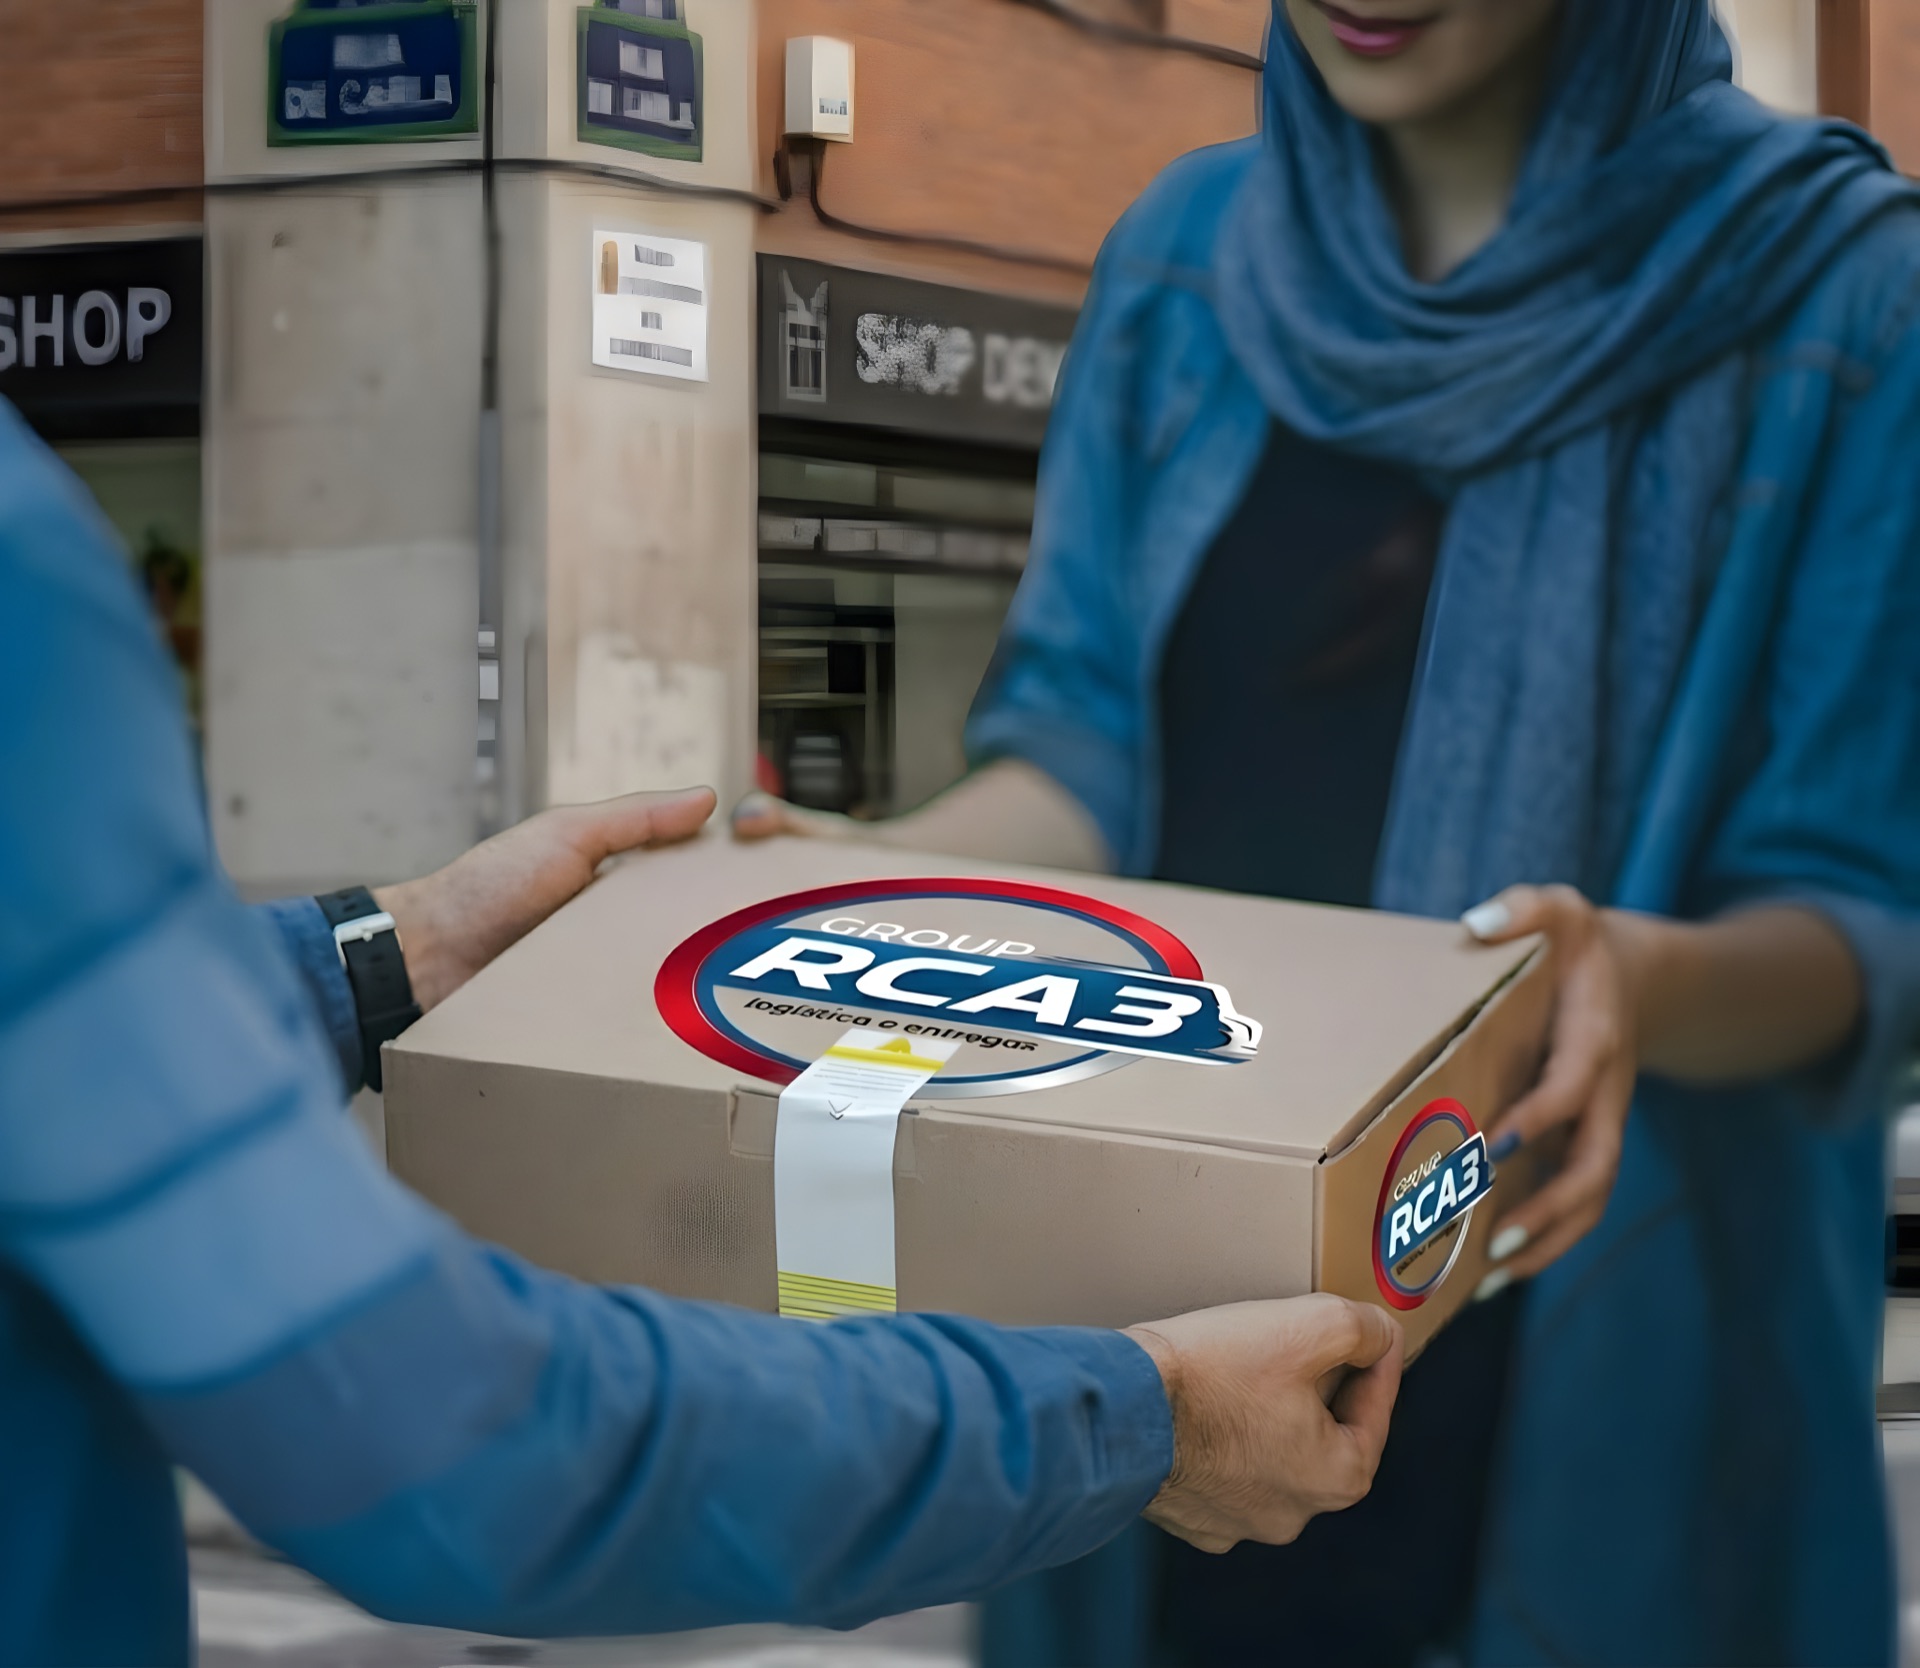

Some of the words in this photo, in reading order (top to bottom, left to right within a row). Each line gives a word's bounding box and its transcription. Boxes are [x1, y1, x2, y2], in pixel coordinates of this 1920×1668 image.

[728, 936, 1203, 1037] RCA3
[820, 916, 1036, 958] GROUP
[1388, 1147, 1480, 1259] RCA3
